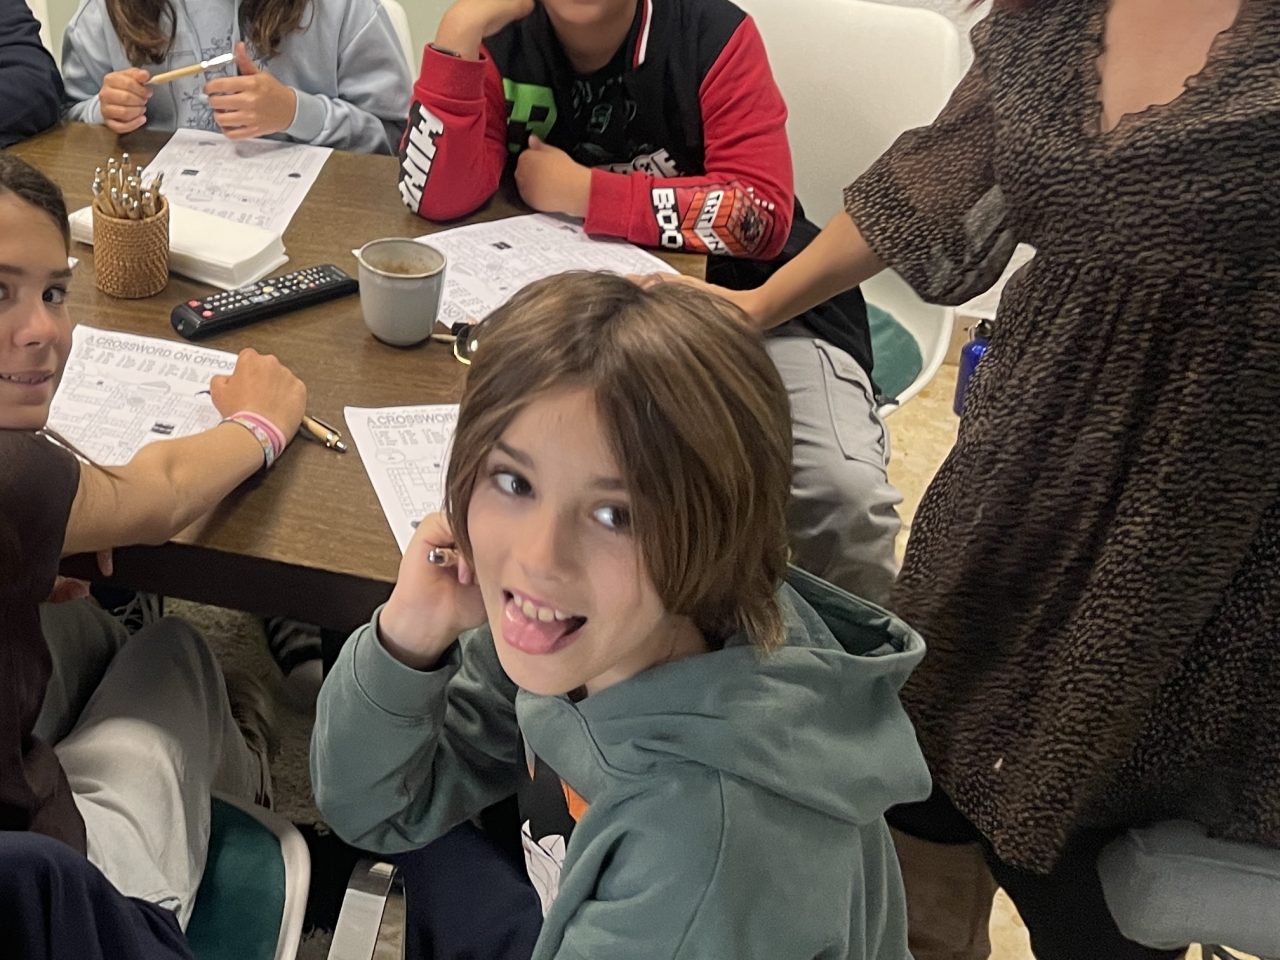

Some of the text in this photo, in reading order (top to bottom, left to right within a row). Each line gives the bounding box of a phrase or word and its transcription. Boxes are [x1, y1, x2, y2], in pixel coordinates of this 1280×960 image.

[700, 193, 722, 224] TNT
[96, 337, 171, 357] CROSSWORD
[173, 351, 192, 360] ON
[194, 354, 235, 369] OPPOS
